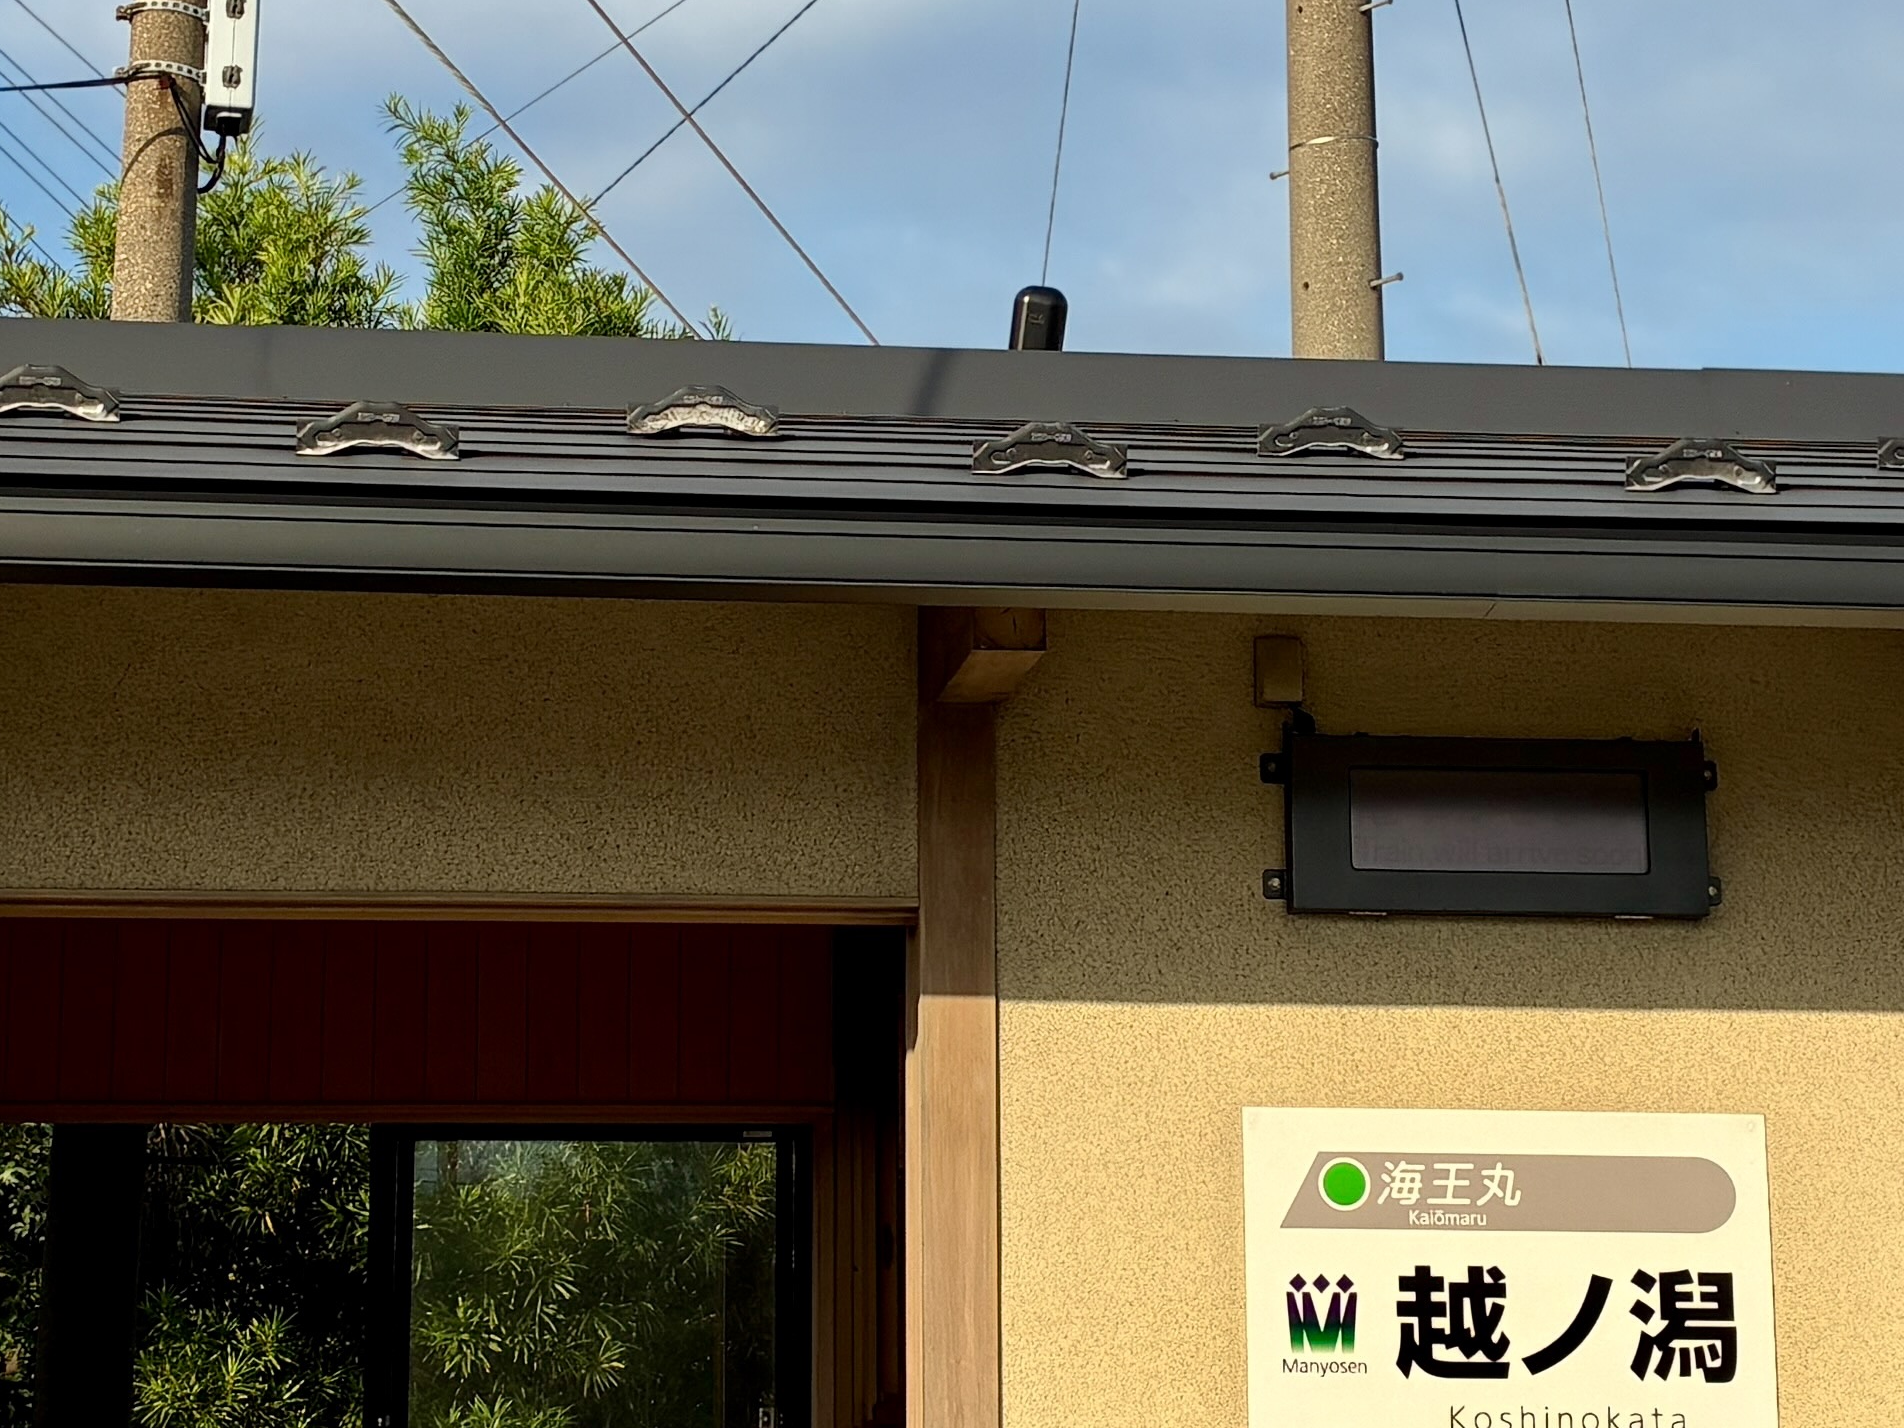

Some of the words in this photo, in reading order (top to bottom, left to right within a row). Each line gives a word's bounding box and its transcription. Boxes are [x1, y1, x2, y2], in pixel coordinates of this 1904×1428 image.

[1377, 1160, 1522, 1206] 海王丸
[1395, 1265, 1738, 1384] 越ノ潟
[1282, 1358, 1368, 1378] Manyosen
